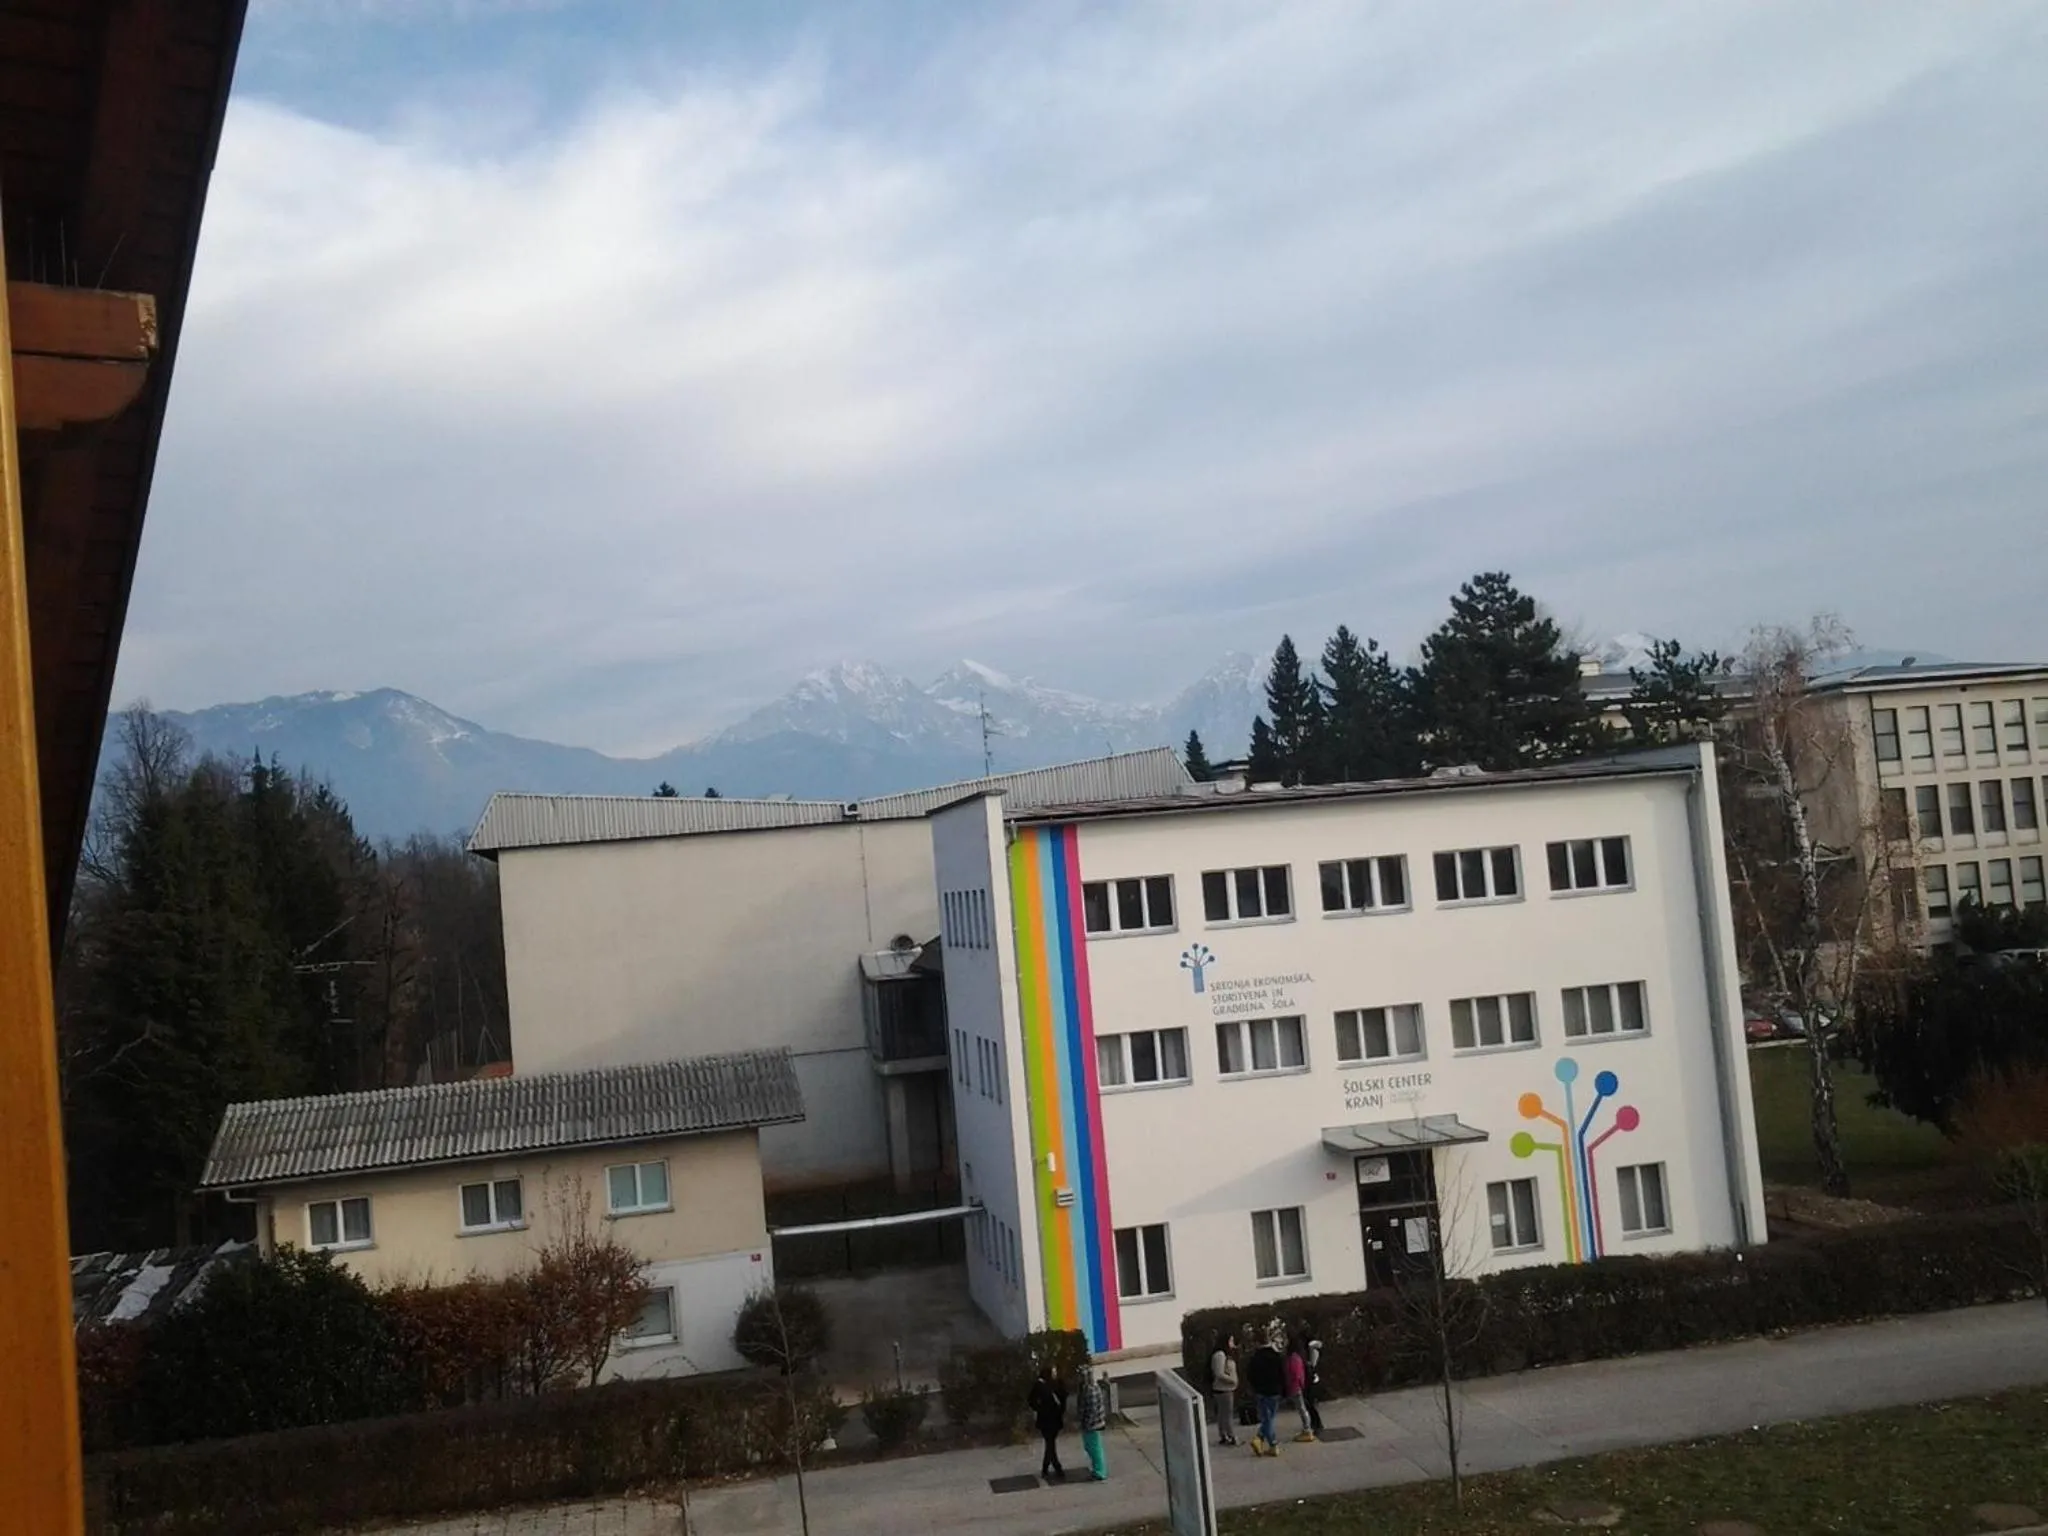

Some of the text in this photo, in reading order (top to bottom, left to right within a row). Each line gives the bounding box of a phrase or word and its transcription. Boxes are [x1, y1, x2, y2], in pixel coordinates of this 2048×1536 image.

[1343, 1072, 1432, 1094] ŠOLSKI CENTER
[1345, 1094, 1383, 1110] KRANJ
